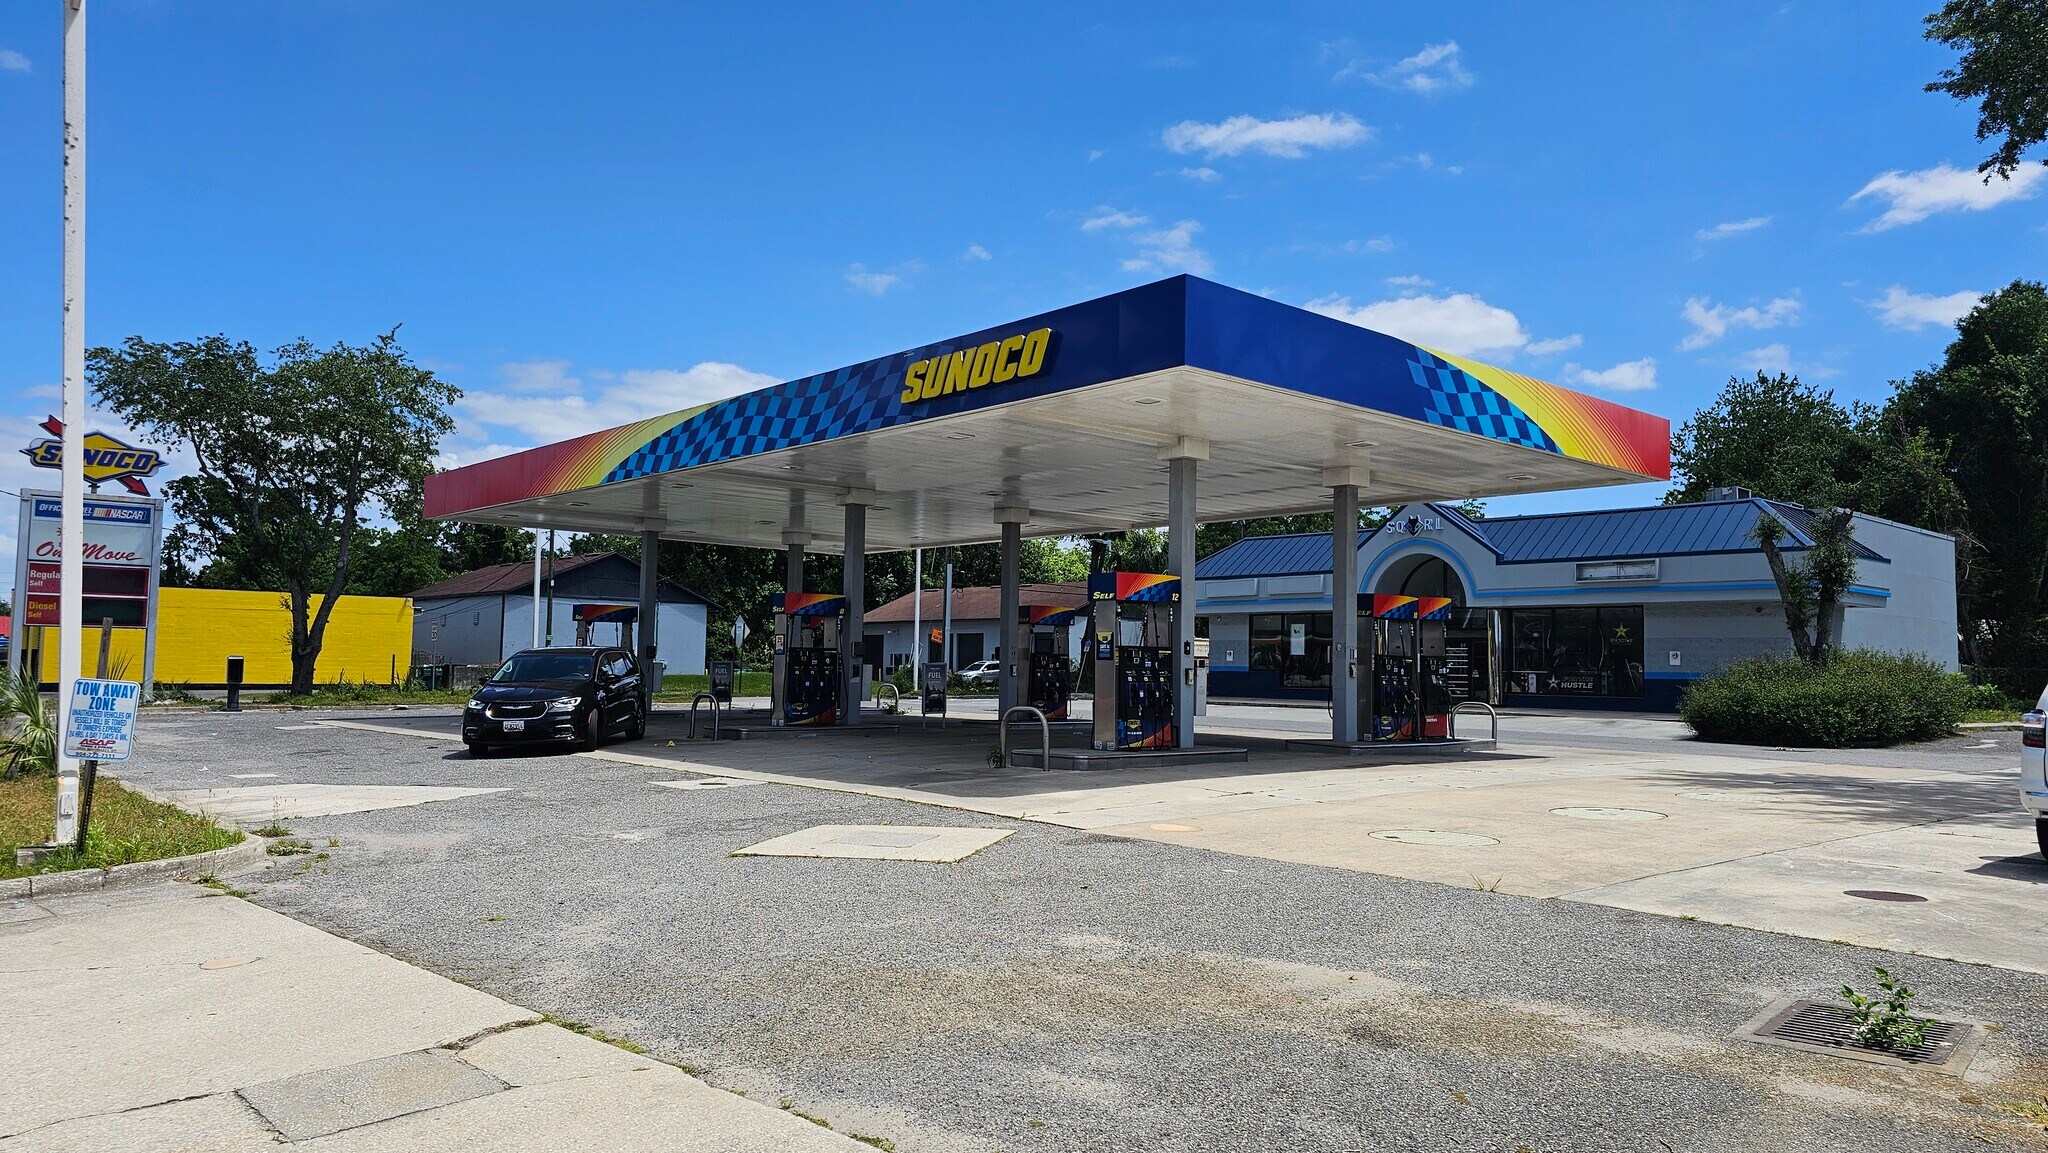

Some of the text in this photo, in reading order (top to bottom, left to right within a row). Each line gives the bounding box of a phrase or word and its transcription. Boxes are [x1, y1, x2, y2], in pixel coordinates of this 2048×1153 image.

[901, 328, 1052, 404] SUNOCO
[40, 445, 153, 470] SNOCO
[39, 503, 62, 512] OFFIC
[110, 508, 144, 520] NASCAR
[30, 570, 61, 580] Regula
[1172, 593, 1179, 601] 12
[28, 601, 57, 610] Diesel
[928, 671, 942, 679] FUEL
[76, 681, 136, 699] TOW AWAY
[89, 696, 117, 711] ZONE
[79, 738, 117, 746] ASAP
